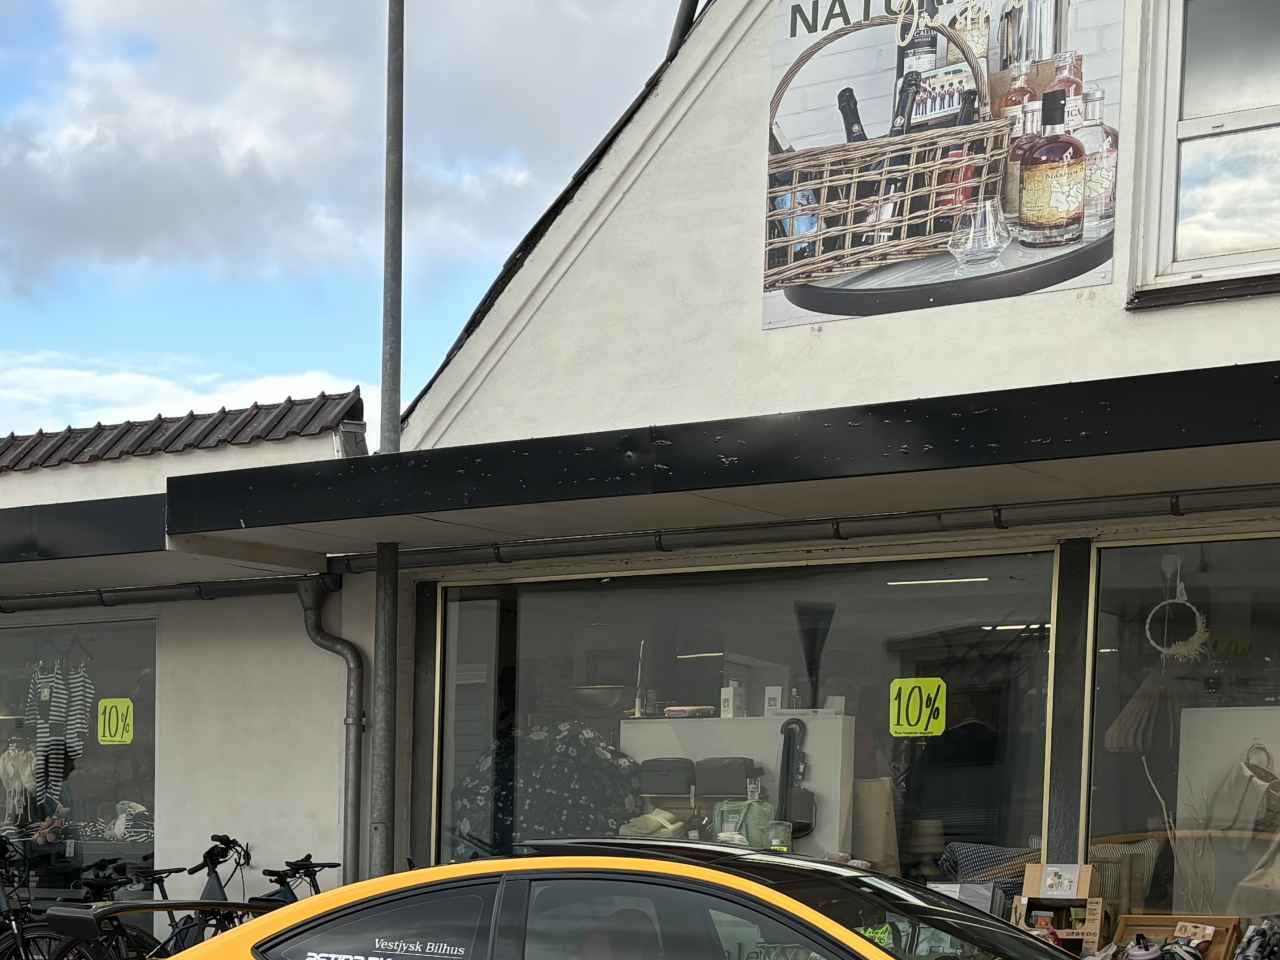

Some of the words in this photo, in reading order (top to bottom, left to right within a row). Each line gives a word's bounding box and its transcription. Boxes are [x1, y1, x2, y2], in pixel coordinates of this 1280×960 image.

[101, 704, 130, 739] 10%
[893, 684, 942, 732] 10%
[374, 938, 423, 953] Vestjysk
[425, 942, 465, 956] Bilhus
